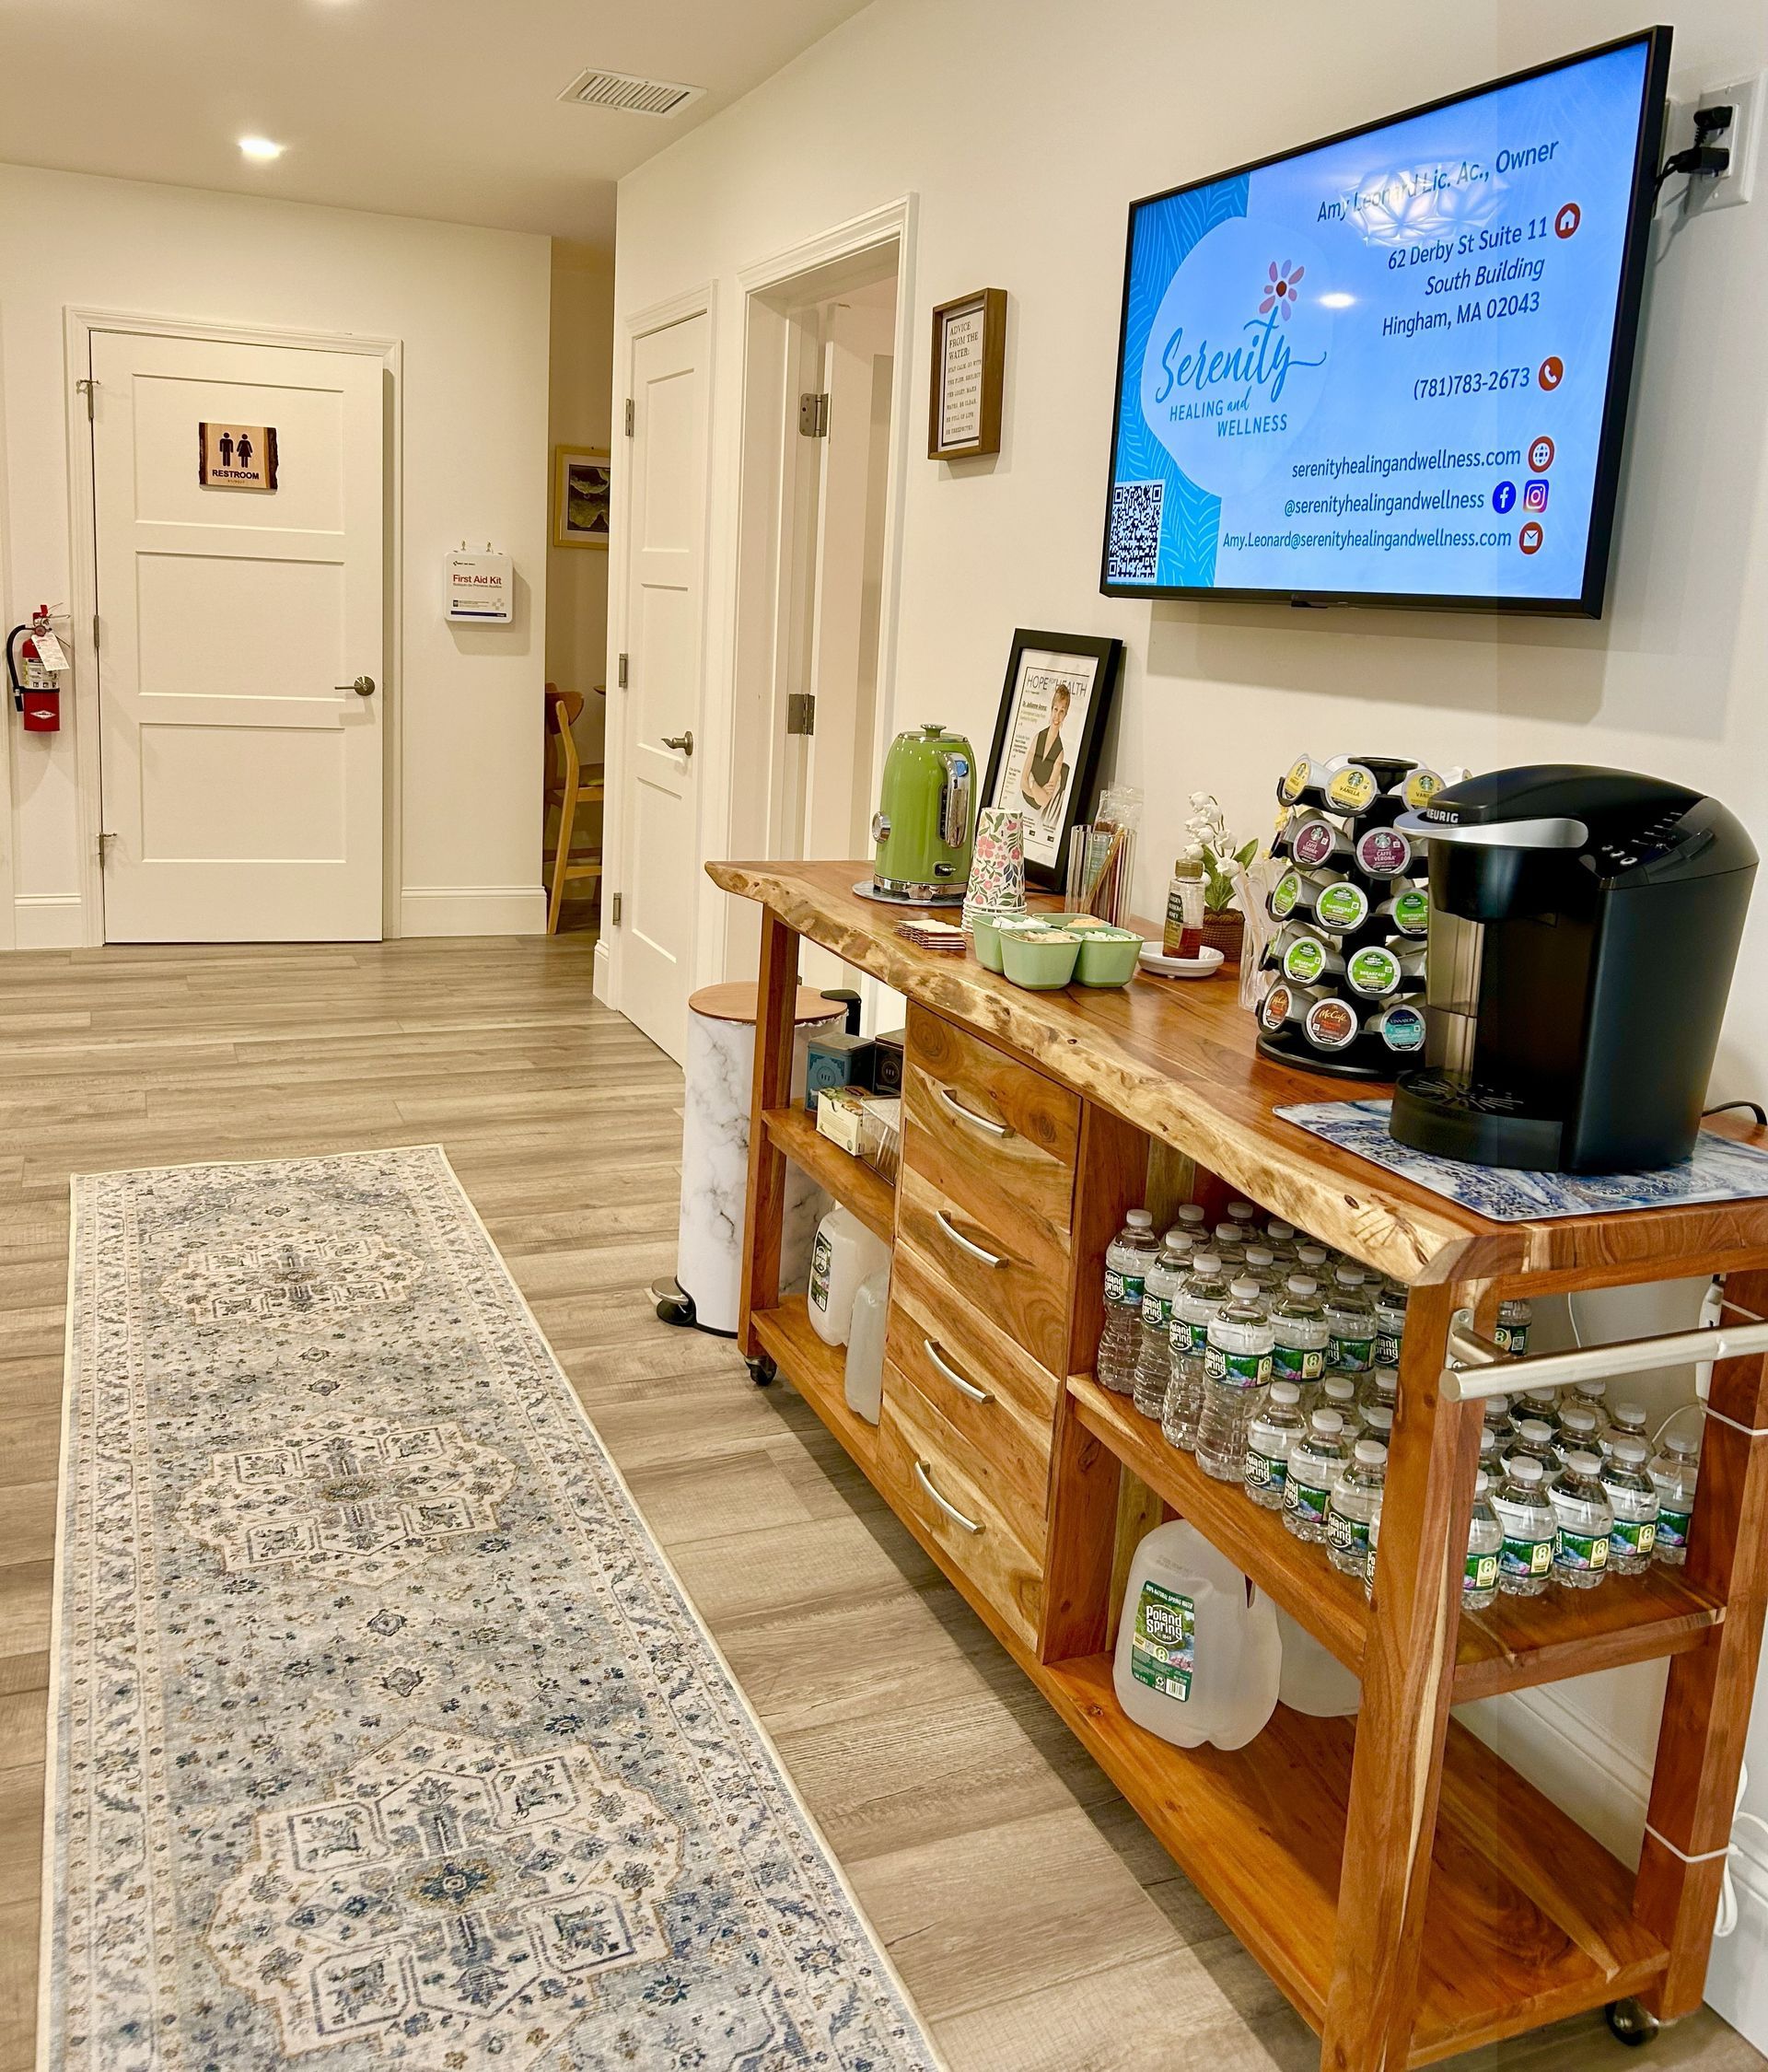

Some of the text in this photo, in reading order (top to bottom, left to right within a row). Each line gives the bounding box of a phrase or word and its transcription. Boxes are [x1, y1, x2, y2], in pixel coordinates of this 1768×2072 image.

[1317, 199, 1349, 222] Amy
[1423, 169, 1451, 192] Lic.
[1457, 161, 1489, 184] Ac.,
[1495, 141, 1559, 173] Owner
[1389, 216, 1547, 270] 62 Derby St Suite 11
[1425, 257, 1545, 296] South Building
[1382, 291, 1541, 338] Hingham, MA 02043
[950, 321, 971, 336] ADVICE
[949, 332, 979, 349] FROM THE
[1155, 305, 1327, 403] Serenity
[1413, 367, 1530, 401] (781)783-2673
[1169, 385, 1252, 422] HEALING and
[1217, 413, 1287, 437] WELLNESS
[212, 469, 259, 480] RESTROOM
[1292, 448, 1520, 479] serenityhealingandwellness.com
[1285, 489, 1484, 517] @serenityhealingandwellness
[1223, 528, 1512, 551] Amy.Leonard@serenityhealingandwellness.com
[453, 574, 502, 585] First Aid Kit
[1026, 674, 1049, 691] HOPE
[1339, 786, 1360, 797] VANILLA
[1426, 809, 1459, 823] KEURIG
[1319, 1008, 1347, 1022] McCafé
[1146, 1605, 1182, 1627] Poland
[1146, 1619, 1183, 1640] Spring
